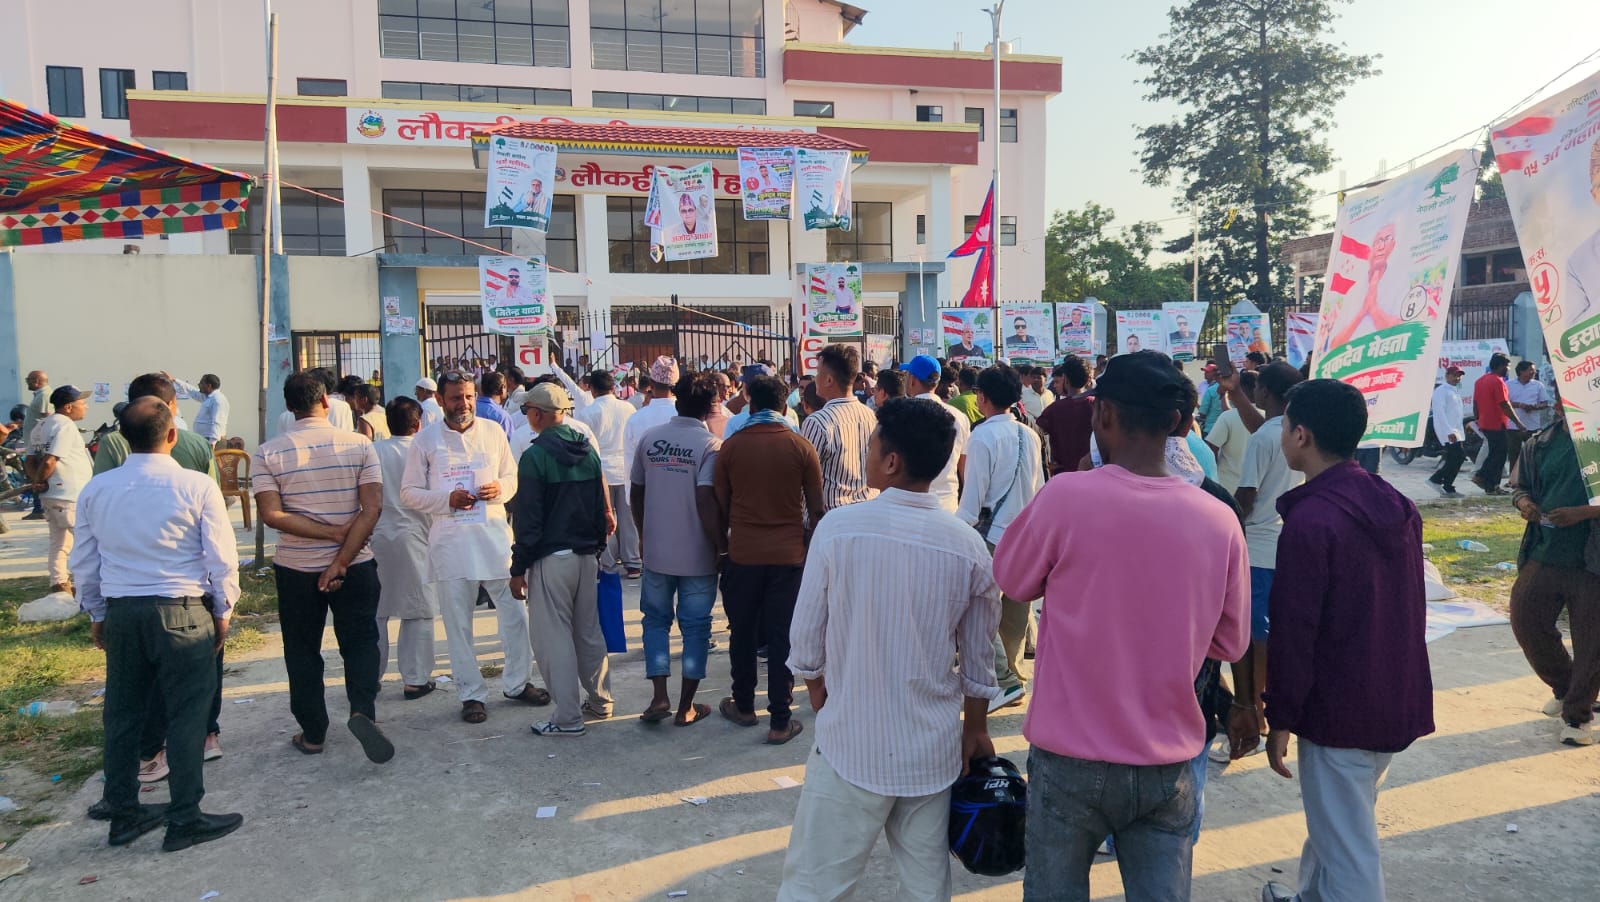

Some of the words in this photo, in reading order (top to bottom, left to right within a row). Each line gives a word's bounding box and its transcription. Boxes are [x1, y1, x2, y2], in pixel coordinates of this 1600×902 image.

[495, 307, 520, 317] जितेन्द्र
[522, 306, 540, 315] यादव
[1367, 332, 1412, 358] मेहता
[1563, 355, 1600, 382] केन्द्री
[646, 440, 695, 458] Shiva
